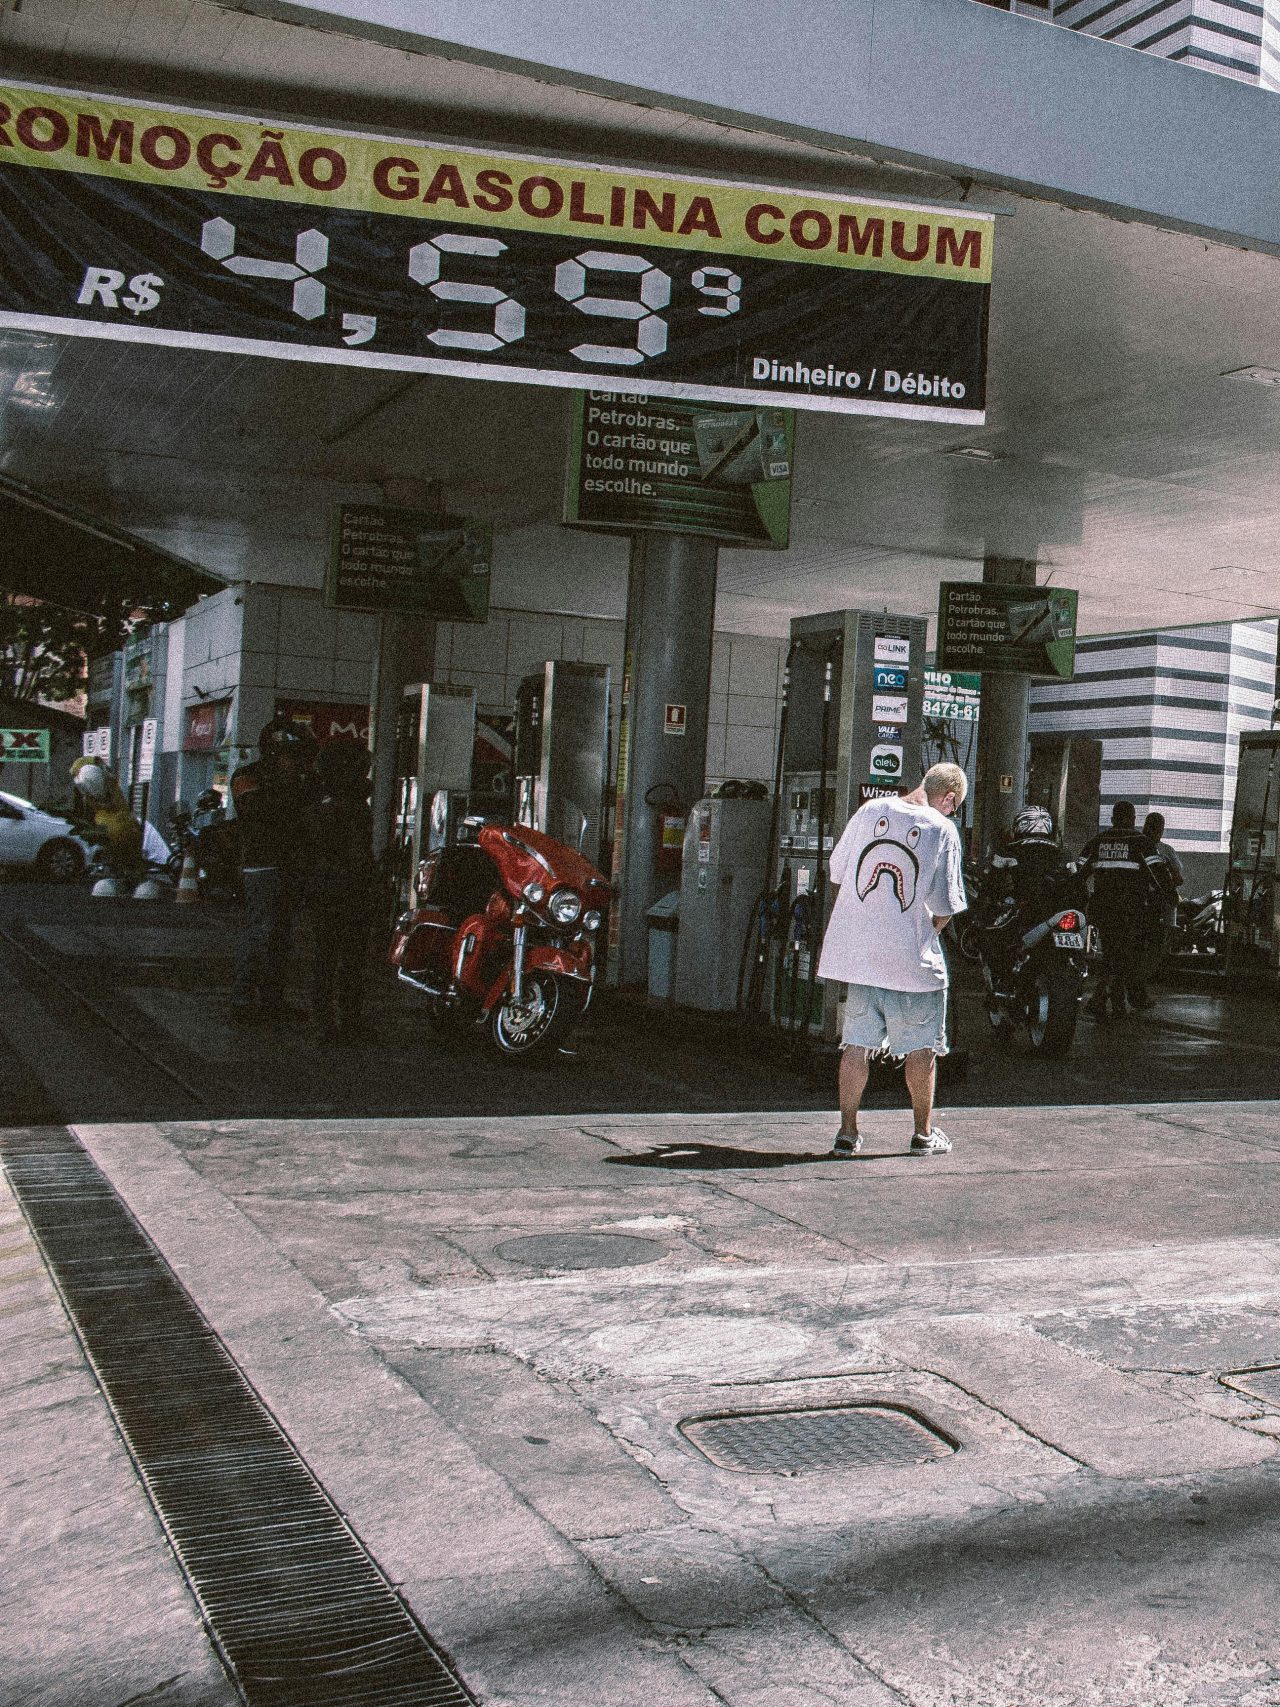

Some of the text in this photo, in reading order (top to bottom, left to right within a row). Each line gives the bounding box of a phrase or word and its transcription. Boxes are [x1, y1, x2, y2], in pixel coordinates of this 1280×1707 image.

[0, 102, 983, 270] OMOÇÃO GASOLINA COMUM
[77, 266, 164, 315] R$
[753, 357, 861, 390] Dinheiro
[883, 370, 967, 399] Débito
[587, 430, 691, 455] O cartão que
[585, 453, 689, 477] todo mundo
[584, 477, 657, 496] escolhe.
[949, 591, 981, 601] Cartão
[947, 617, 1006, 630] O cartão que
[946, 631, 1005, 642] todo mundo
[877, 672, 905, 686] neo
[1099, 841, 1129, 851] POLÍCIA
[1098, 850, 1129, 860] MILITAR
